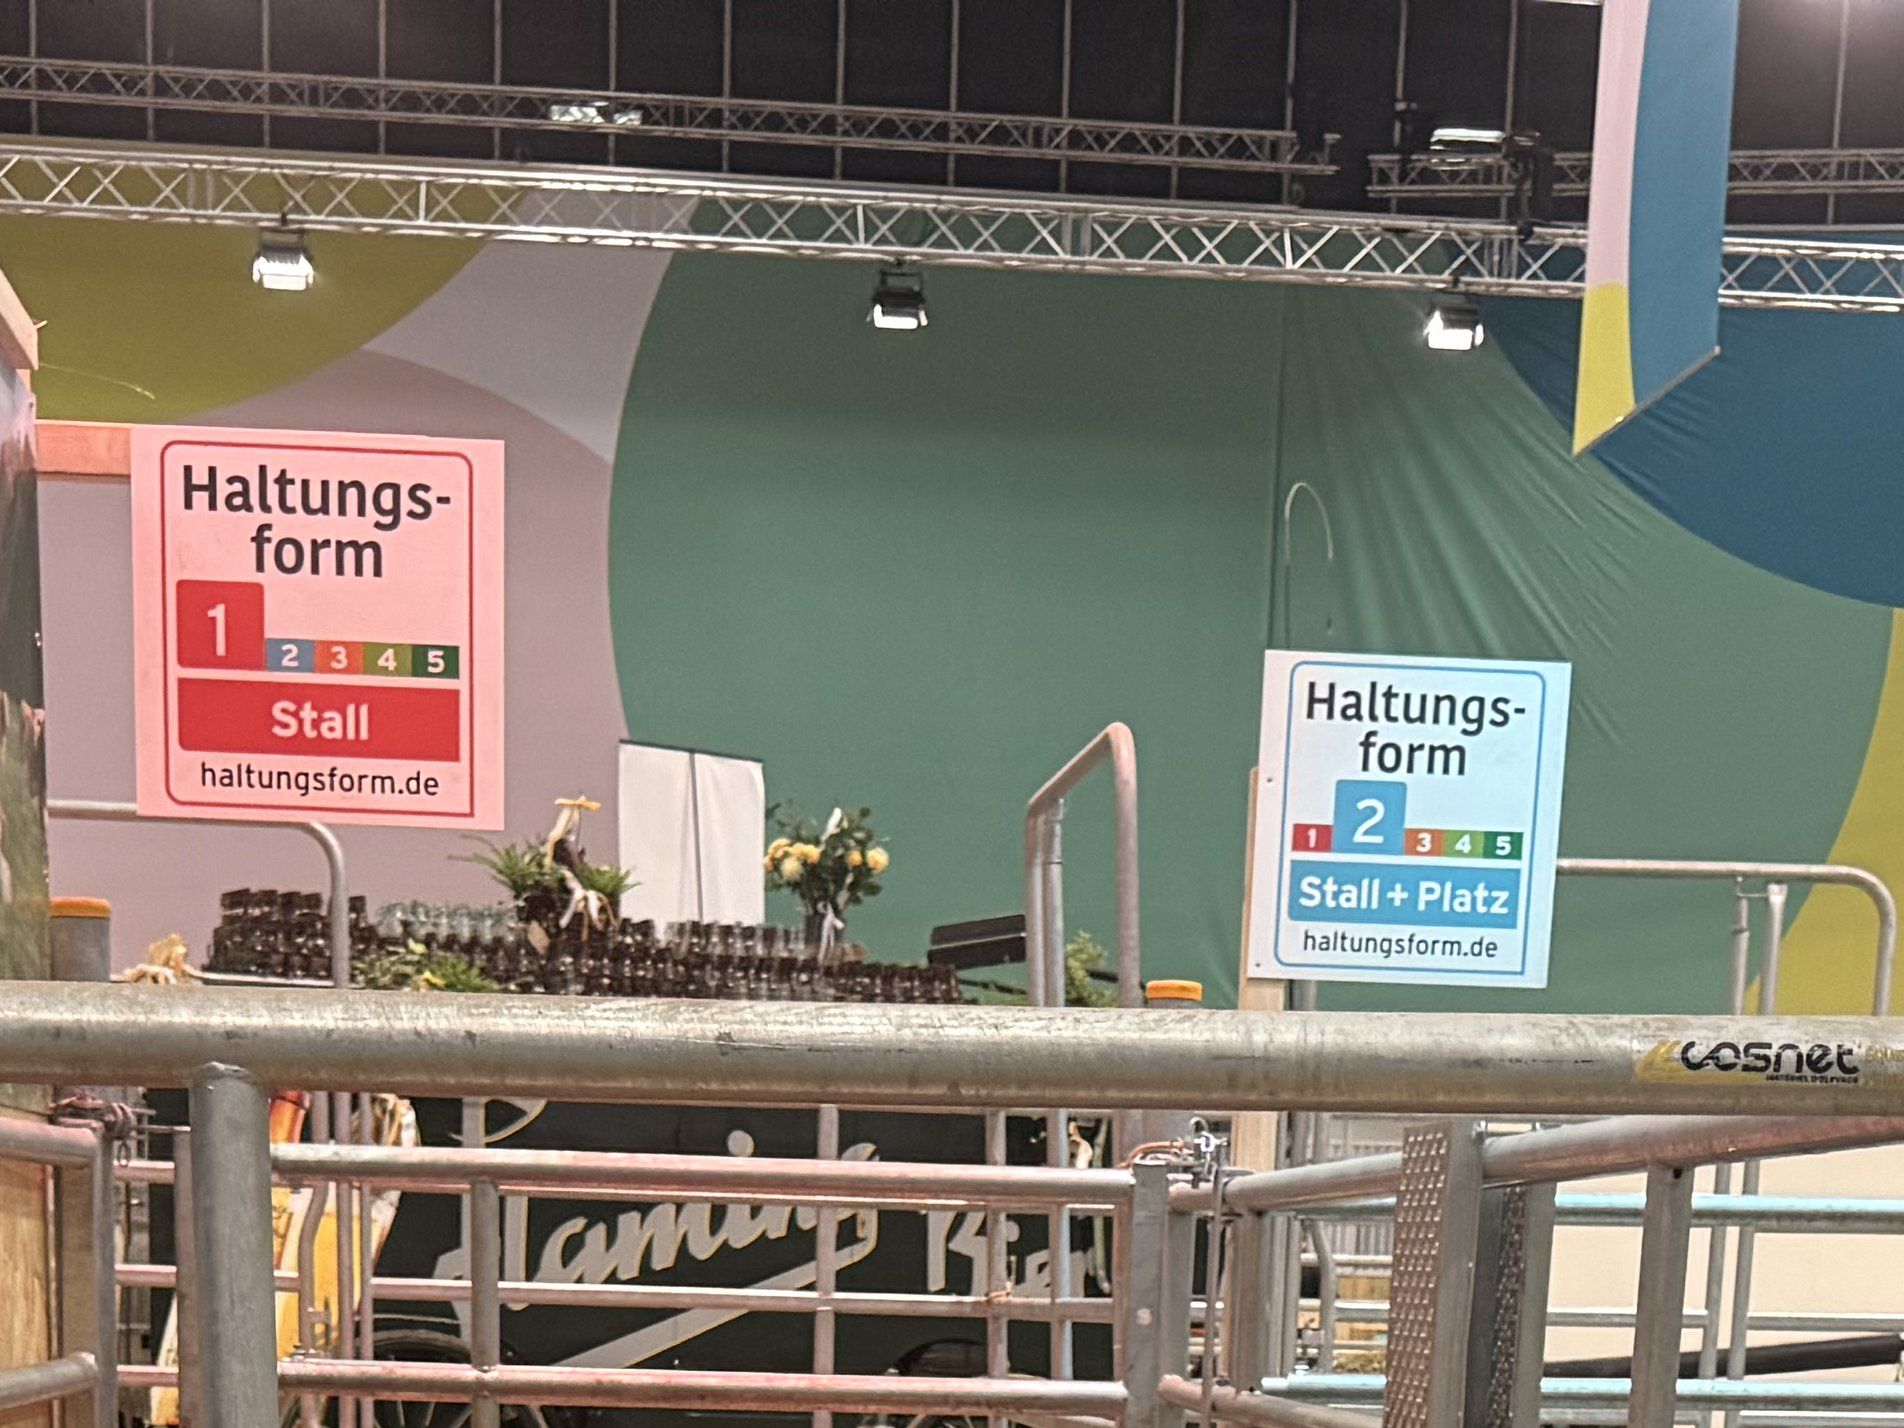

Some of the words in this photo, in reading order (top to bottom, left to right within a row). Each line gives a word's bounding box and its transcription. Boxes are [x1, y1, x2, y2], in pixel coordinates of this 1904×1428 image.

[182, 465, 452, 532] Haltungs-
[250, 523, 383, 578] form
[206, 603, 227, 656] 1
[280, 643, 299, 668] 2
[329, 646, 347, 670] 3
[377, 648, 397, 672] 4
[426, 650, 444, 674] 5
[271, 699, 370, 742] Stall
[1305, 681, 1527, 738] Haltungs-
[1358, 731, 1468, 777] form
[198, 761, 441, 799] haltungsform.de
[1305, 827, 1316, 848] 1
[1352, 798, 1386, 845] 2
[1416, 833, 1432, 853] 3
[1454, 834, 1472, 854] 4
[1494, 835, 1512, 856] 5
[1298, 876, 1380, 911] Stall
[1386, 884, 1409, 908] +
[1416, 880, 1510, 916] Platz
[1302, 930, 1499, 961] haltungsform.de
